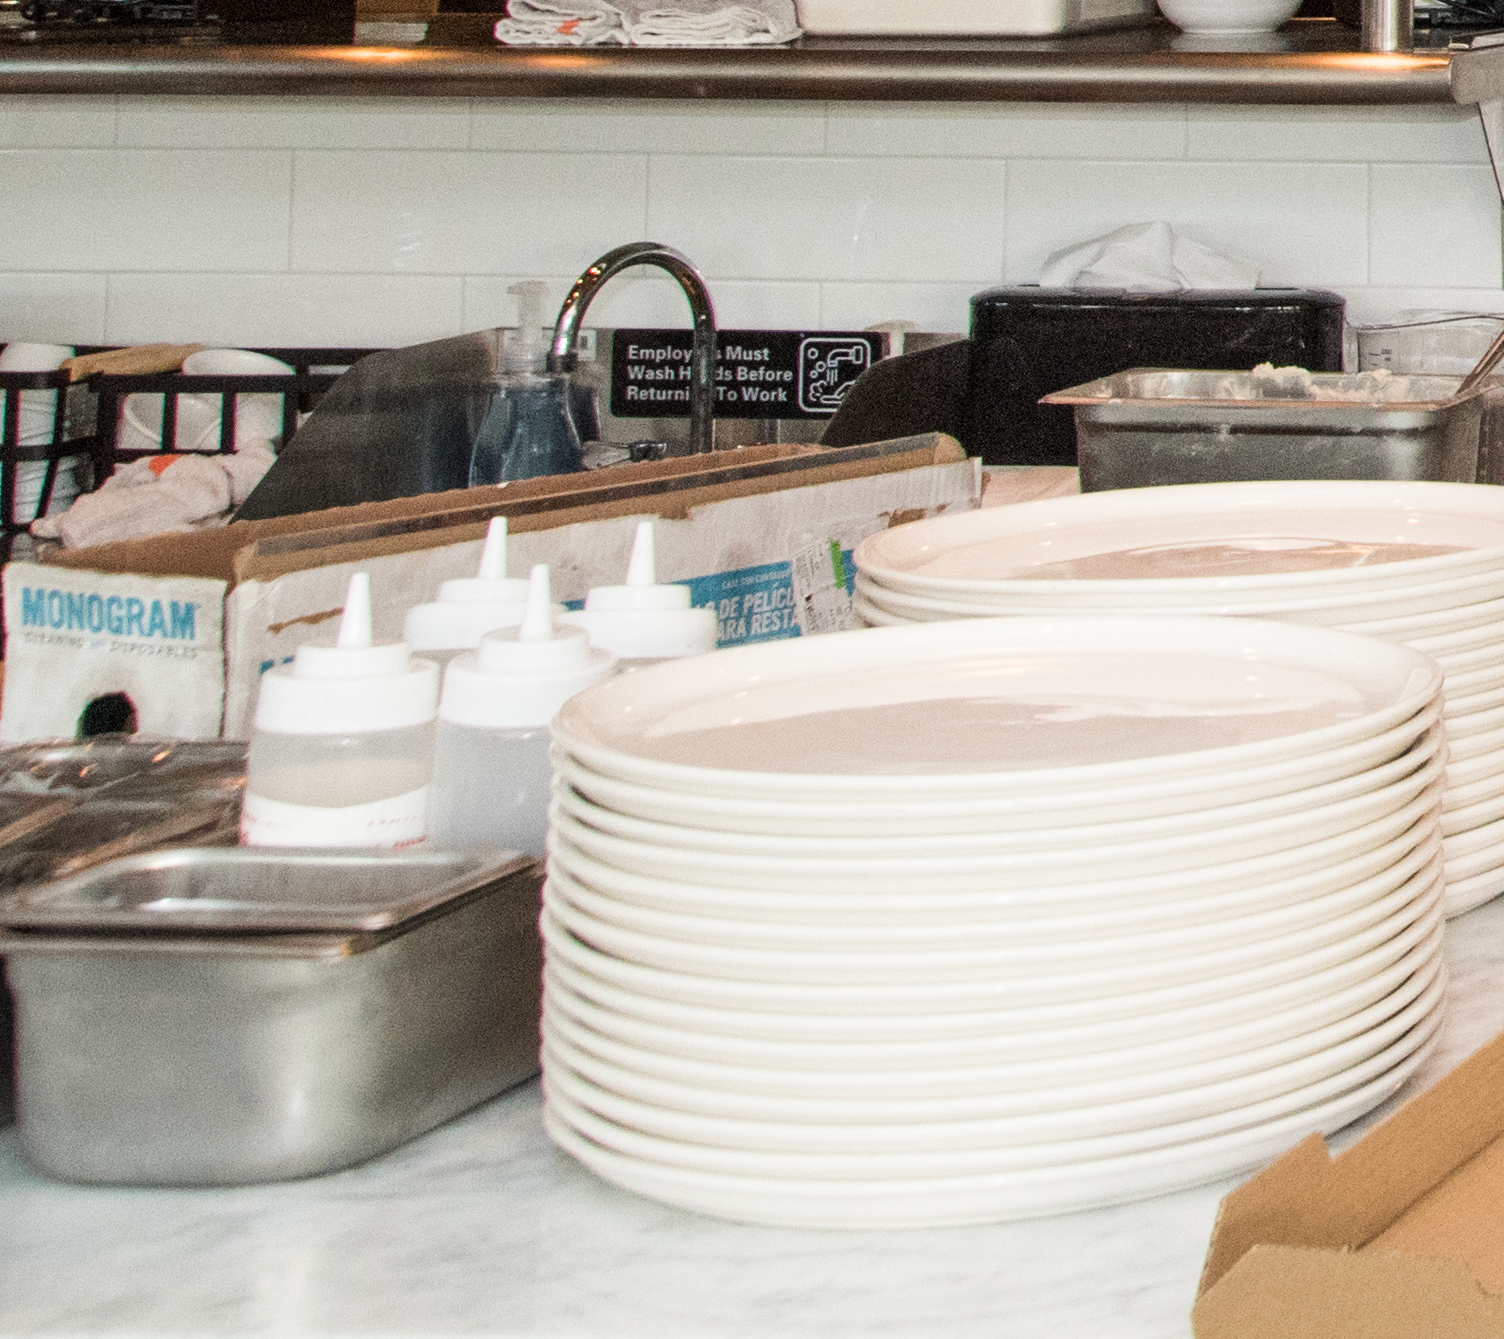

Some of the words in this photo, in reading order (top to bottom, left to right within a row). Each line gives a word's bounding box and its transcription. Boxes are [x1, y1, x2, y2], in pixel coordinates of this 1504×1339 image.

[627, 345, 721, 362] Employs
[726, 346, 770, 361] Must
[627, 365, 674, 380] Wash
[736, 366, 794, 381] Before
[626, 386, 690, 401] Returni
[716, 387, 738, 401] To
[742, 386, 788, 402] Work
[21, 587, 196, 640] MONOGRAM
